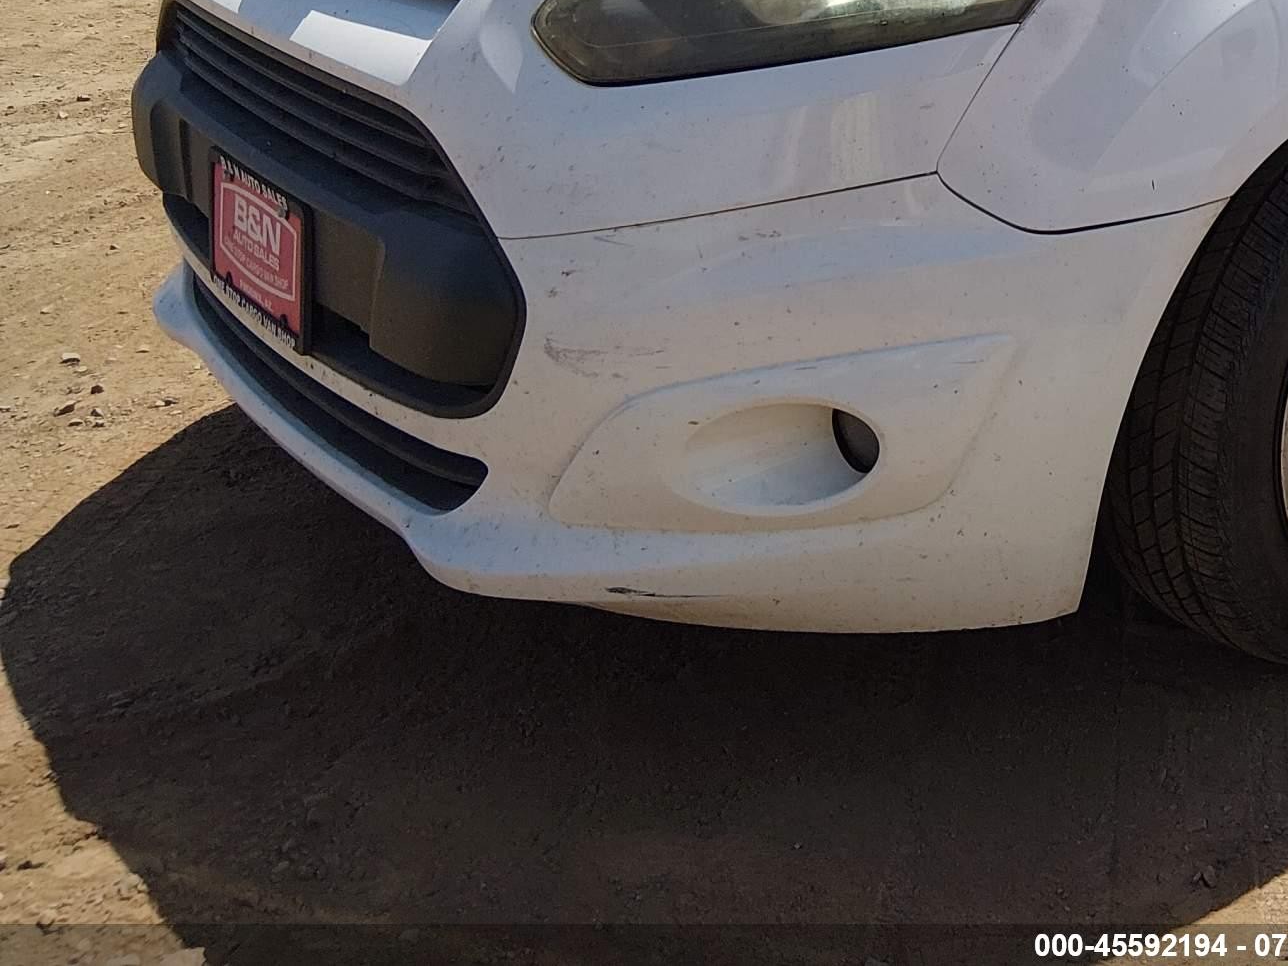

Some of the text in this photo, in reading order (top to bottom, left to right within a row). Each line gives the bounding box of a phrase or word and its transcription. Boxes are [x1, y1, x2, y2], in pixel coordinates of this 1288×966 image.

[241, 169, 261, 194] AUTO
[262, 184, 288, 211] SALES
[233, 229, 280, 271] AUTO SALES
[234, 194, 281, 256] B&N
[213, 275, 225, 291] ONE
[226, 285, 241, 305] STOP
[241, 298, 262, 323] CARGO
[263, 315, 277, 336] VAN
[277, 327, 296, 349] SHOP
